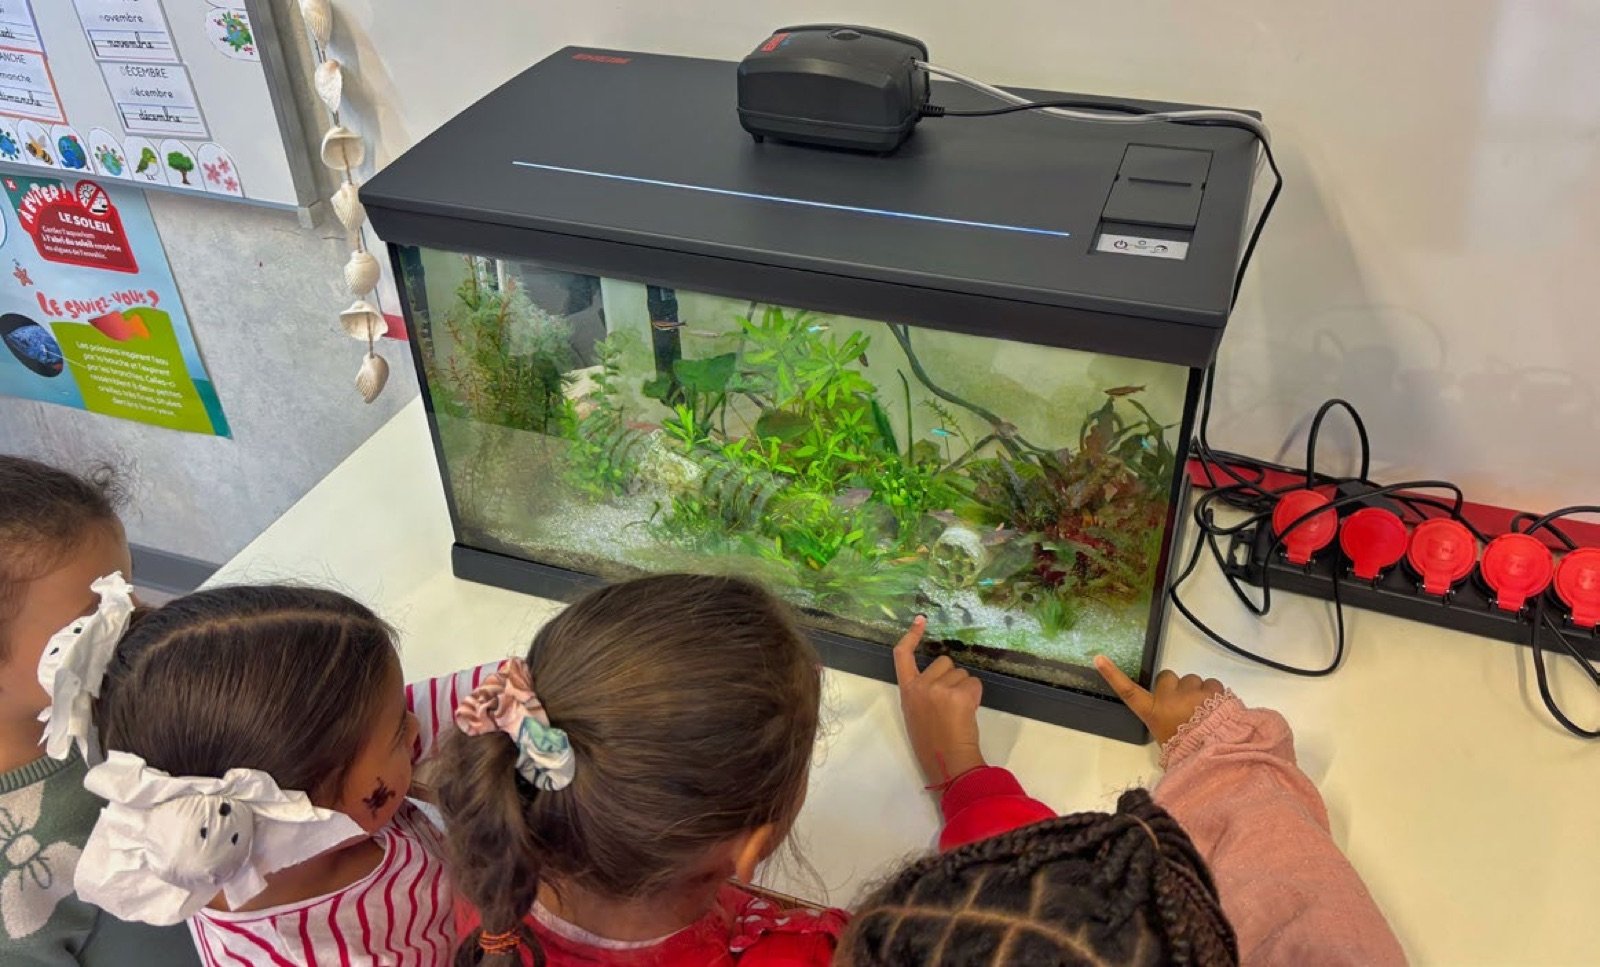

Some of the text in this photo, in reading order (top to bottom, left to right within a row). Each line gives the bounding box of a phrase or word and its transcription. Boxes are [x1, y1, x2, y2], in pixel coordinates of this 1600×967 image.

[58, 211, 114, 235] LE SOLEIL
[64, 289, 147, 319] SAVIEZ-VOUS
